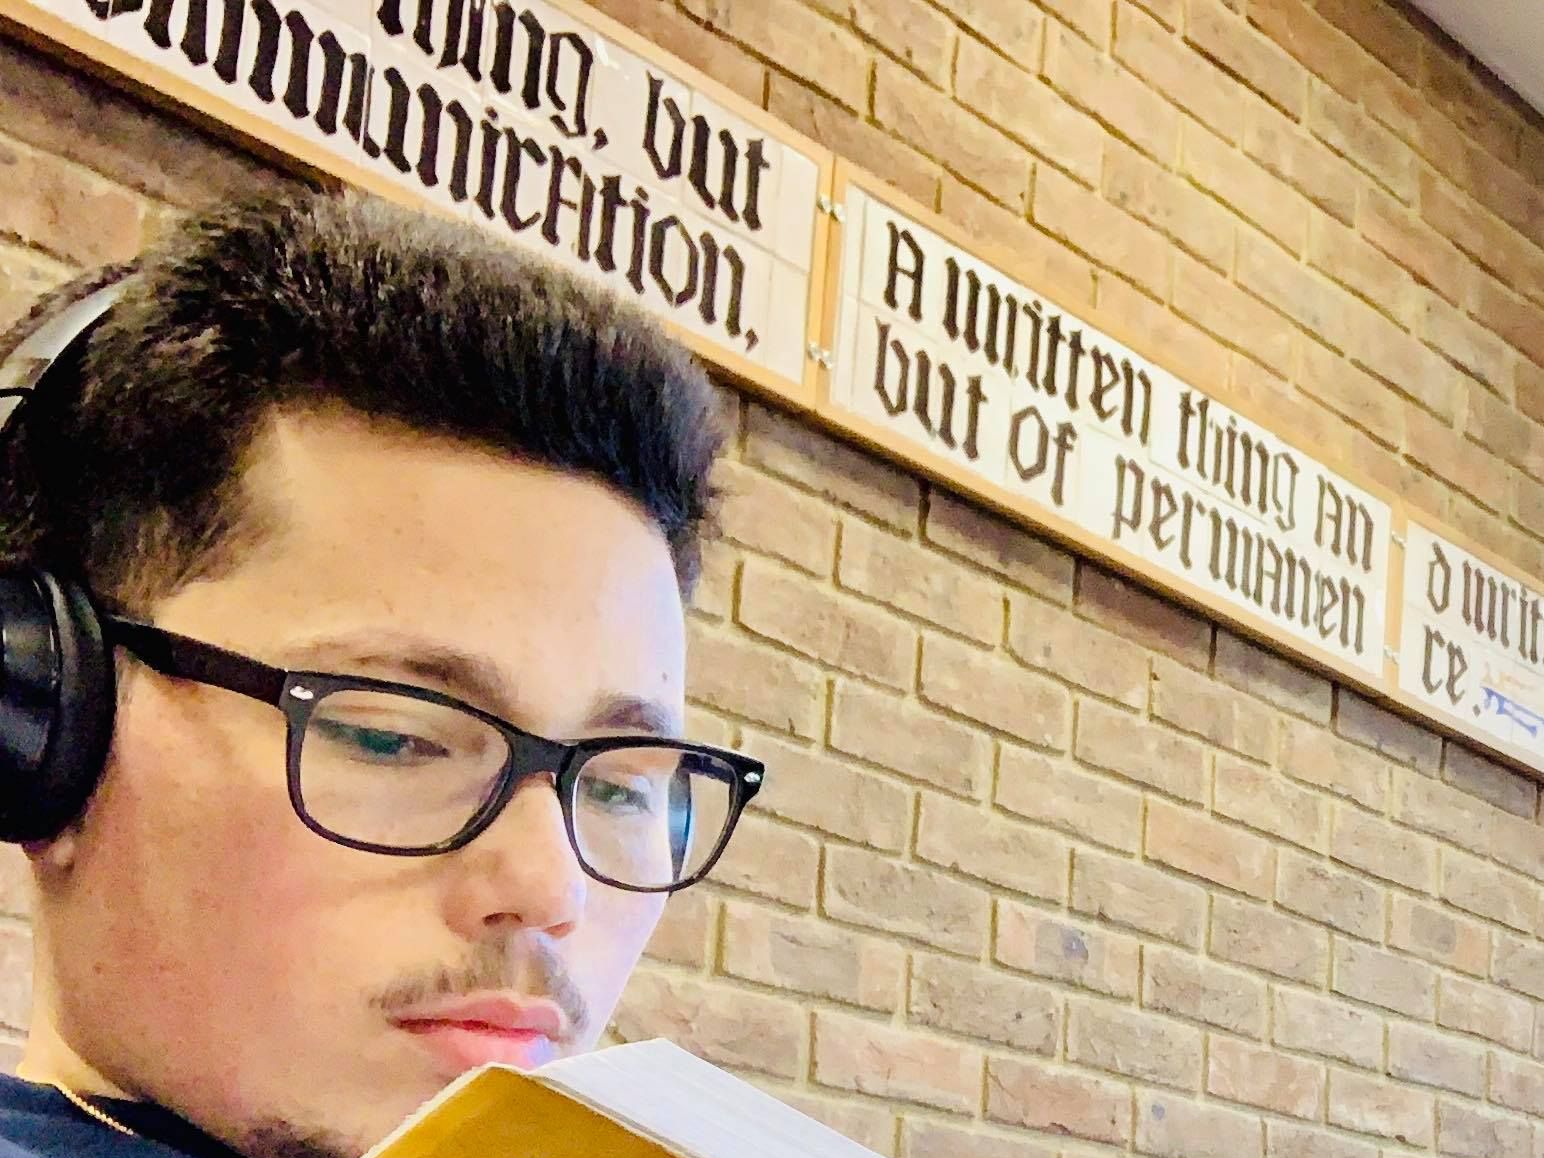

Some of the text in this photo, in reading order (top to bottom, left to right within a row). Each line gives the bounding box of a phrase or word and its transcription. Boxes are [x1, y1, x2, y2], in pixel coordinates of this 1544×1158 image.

[642, 70, 771, 230] but
[875, 316, 988, 461] but
[884, 221, 925, 321] A
[943, 256, 1152, 447] written
[1177, 389, 1300, 532] thing
